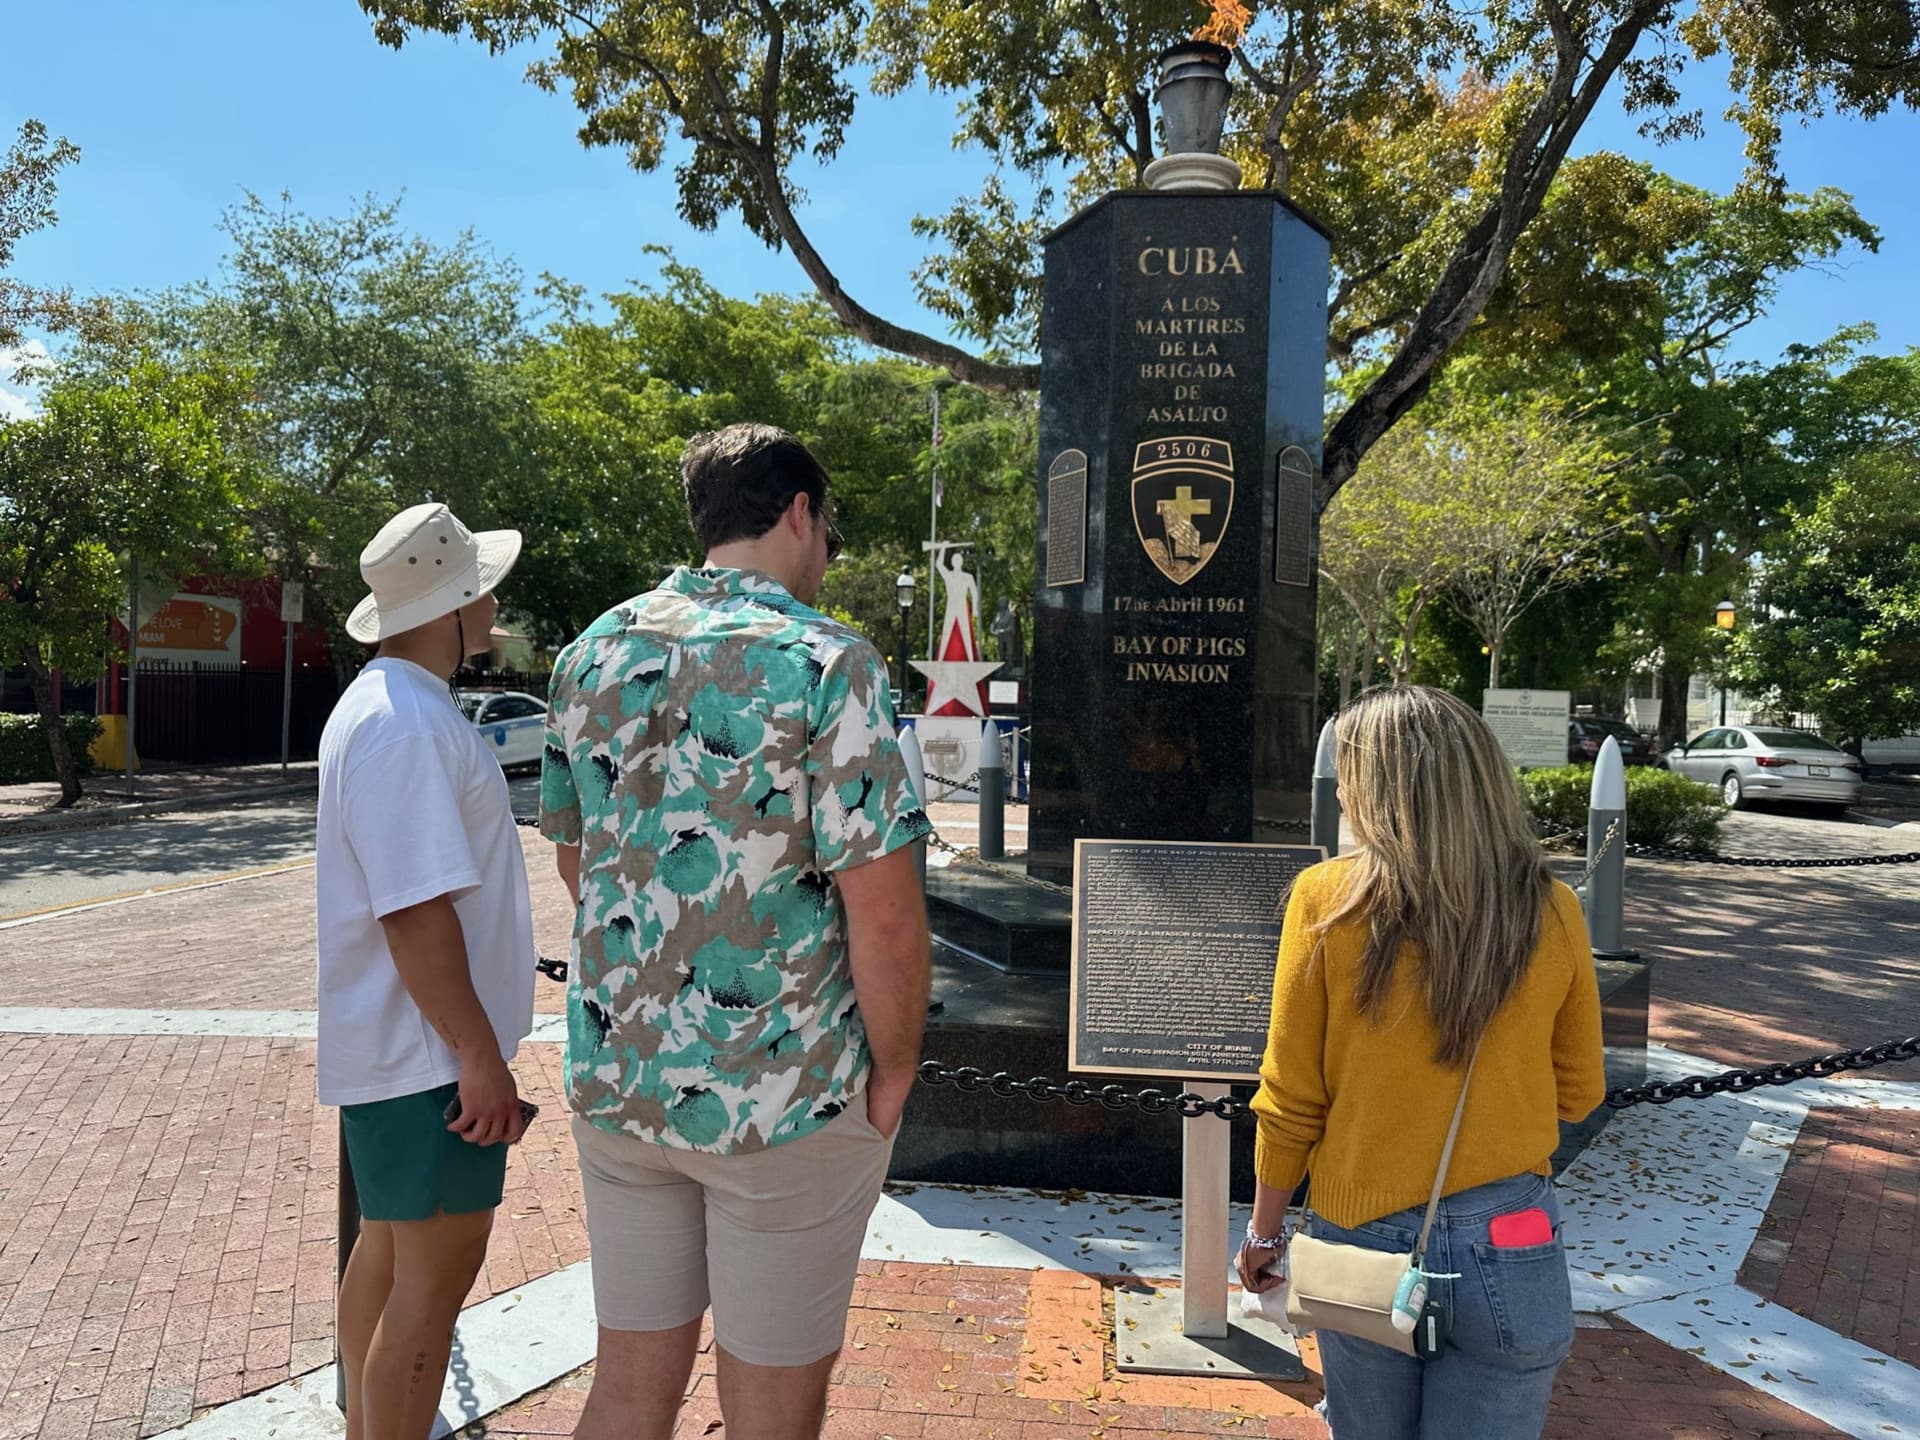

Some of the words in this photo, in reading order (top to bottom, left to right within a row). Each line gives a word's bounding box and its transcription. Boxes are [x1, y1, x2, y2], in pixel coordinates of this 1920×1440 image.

[1137, 247, 1245, 276] CUBA
[1161, 297, 1174, 313] A
[1181, 297, 1221, 313] LOS
[1135, 318, 1246, 335] MARTIRES
[1158, 341, 1186, 357] DE
[1192, 341, 1218, 356] LA
[1140, 363, 1237, 379] BRIGADA
[1174, 385, 1201, 401] DE
[1145, 406, 1228, 423] ASALTO
[1157, 441, 1211, 459] 2506
[1113, 596, 1132, 612] 17
[1155, 597, 1202, 613] Abril
[1207, 598, 1246, 613] 1961
[139, 631, 165, 643] MIAMI
[1112, 635, 1157, 655] BAY
[1161, 636, 1192, 656] OF
[1196, 637, 1246, 657] PIGS
[1126, 662, 1230, 683] INVASION
